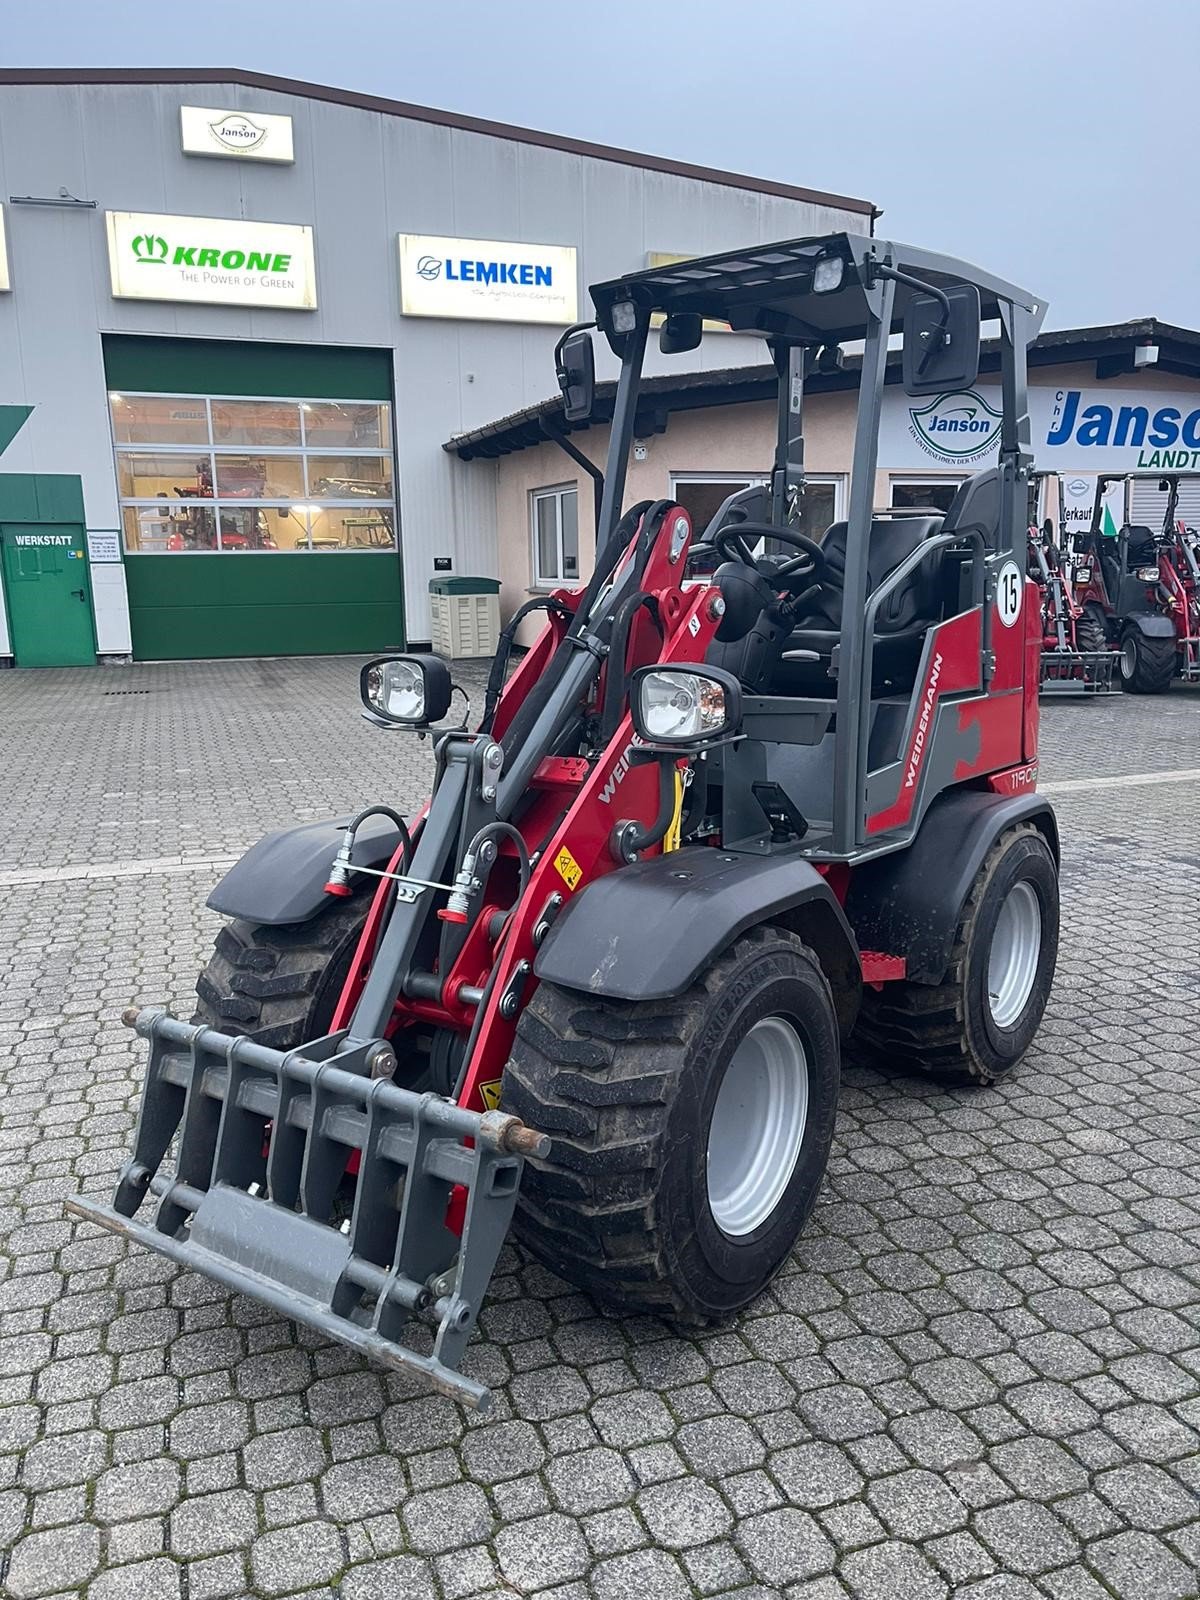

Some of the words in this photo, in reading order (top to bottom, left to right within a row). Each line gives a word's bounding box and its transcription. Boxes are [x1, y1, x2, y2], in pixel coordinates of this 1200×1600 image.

[220, 127, 256, 138] Janson
[172, 246, 292, 273] KRONE
[446, 259, 552, 287] LEMKEN
[928, 415, 990, 433] Janson
[15, 535, 73, 546] WERKSTATT
[1003, 573, 1018, 615] 15
[905, 652, 943, 788] WEIDEMANN
